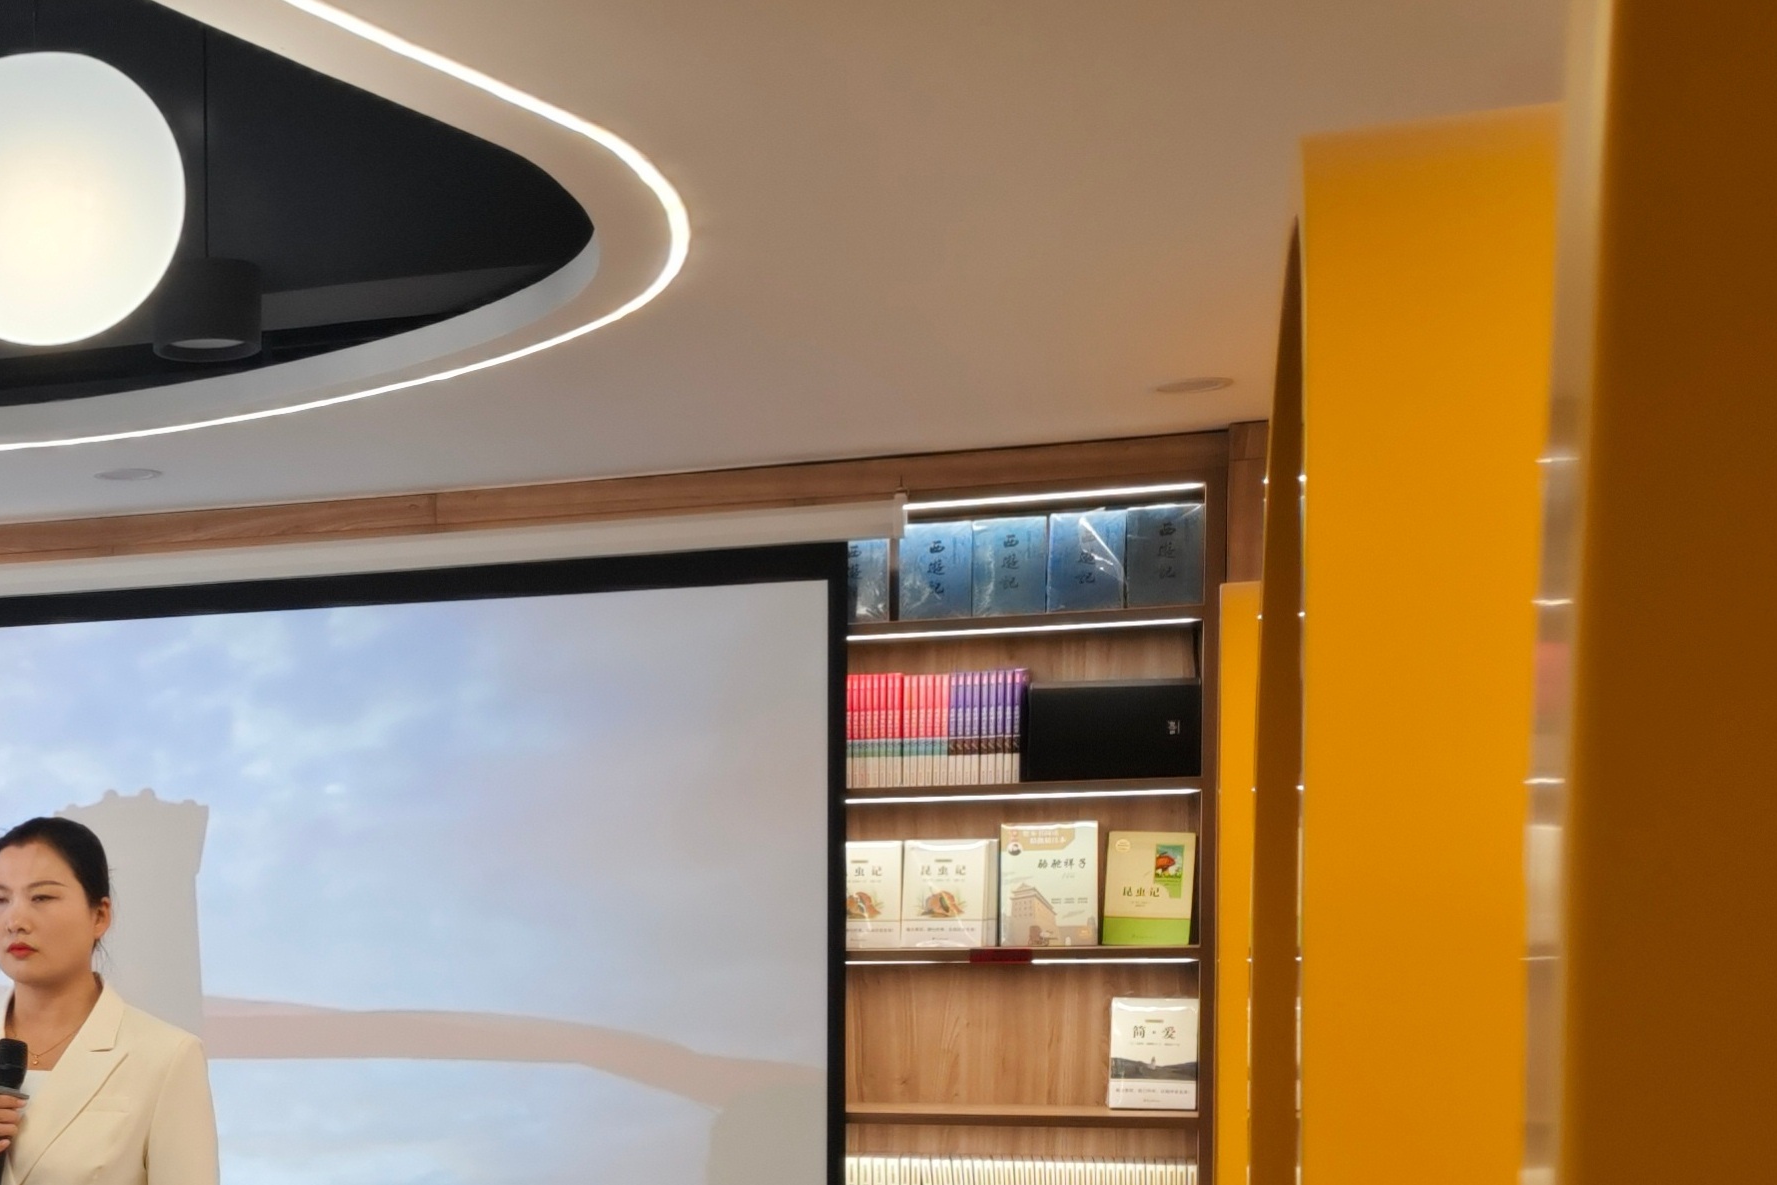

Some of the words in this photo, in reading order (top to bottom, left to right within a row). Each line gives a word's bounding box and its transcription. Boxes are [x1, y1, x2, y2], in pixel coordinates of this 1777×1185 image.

[846, 865, 883, 877] 虫记
[920, 865, 966, 877] 昆虫记
[1122, 885, 1160, 897] 昆虫记
